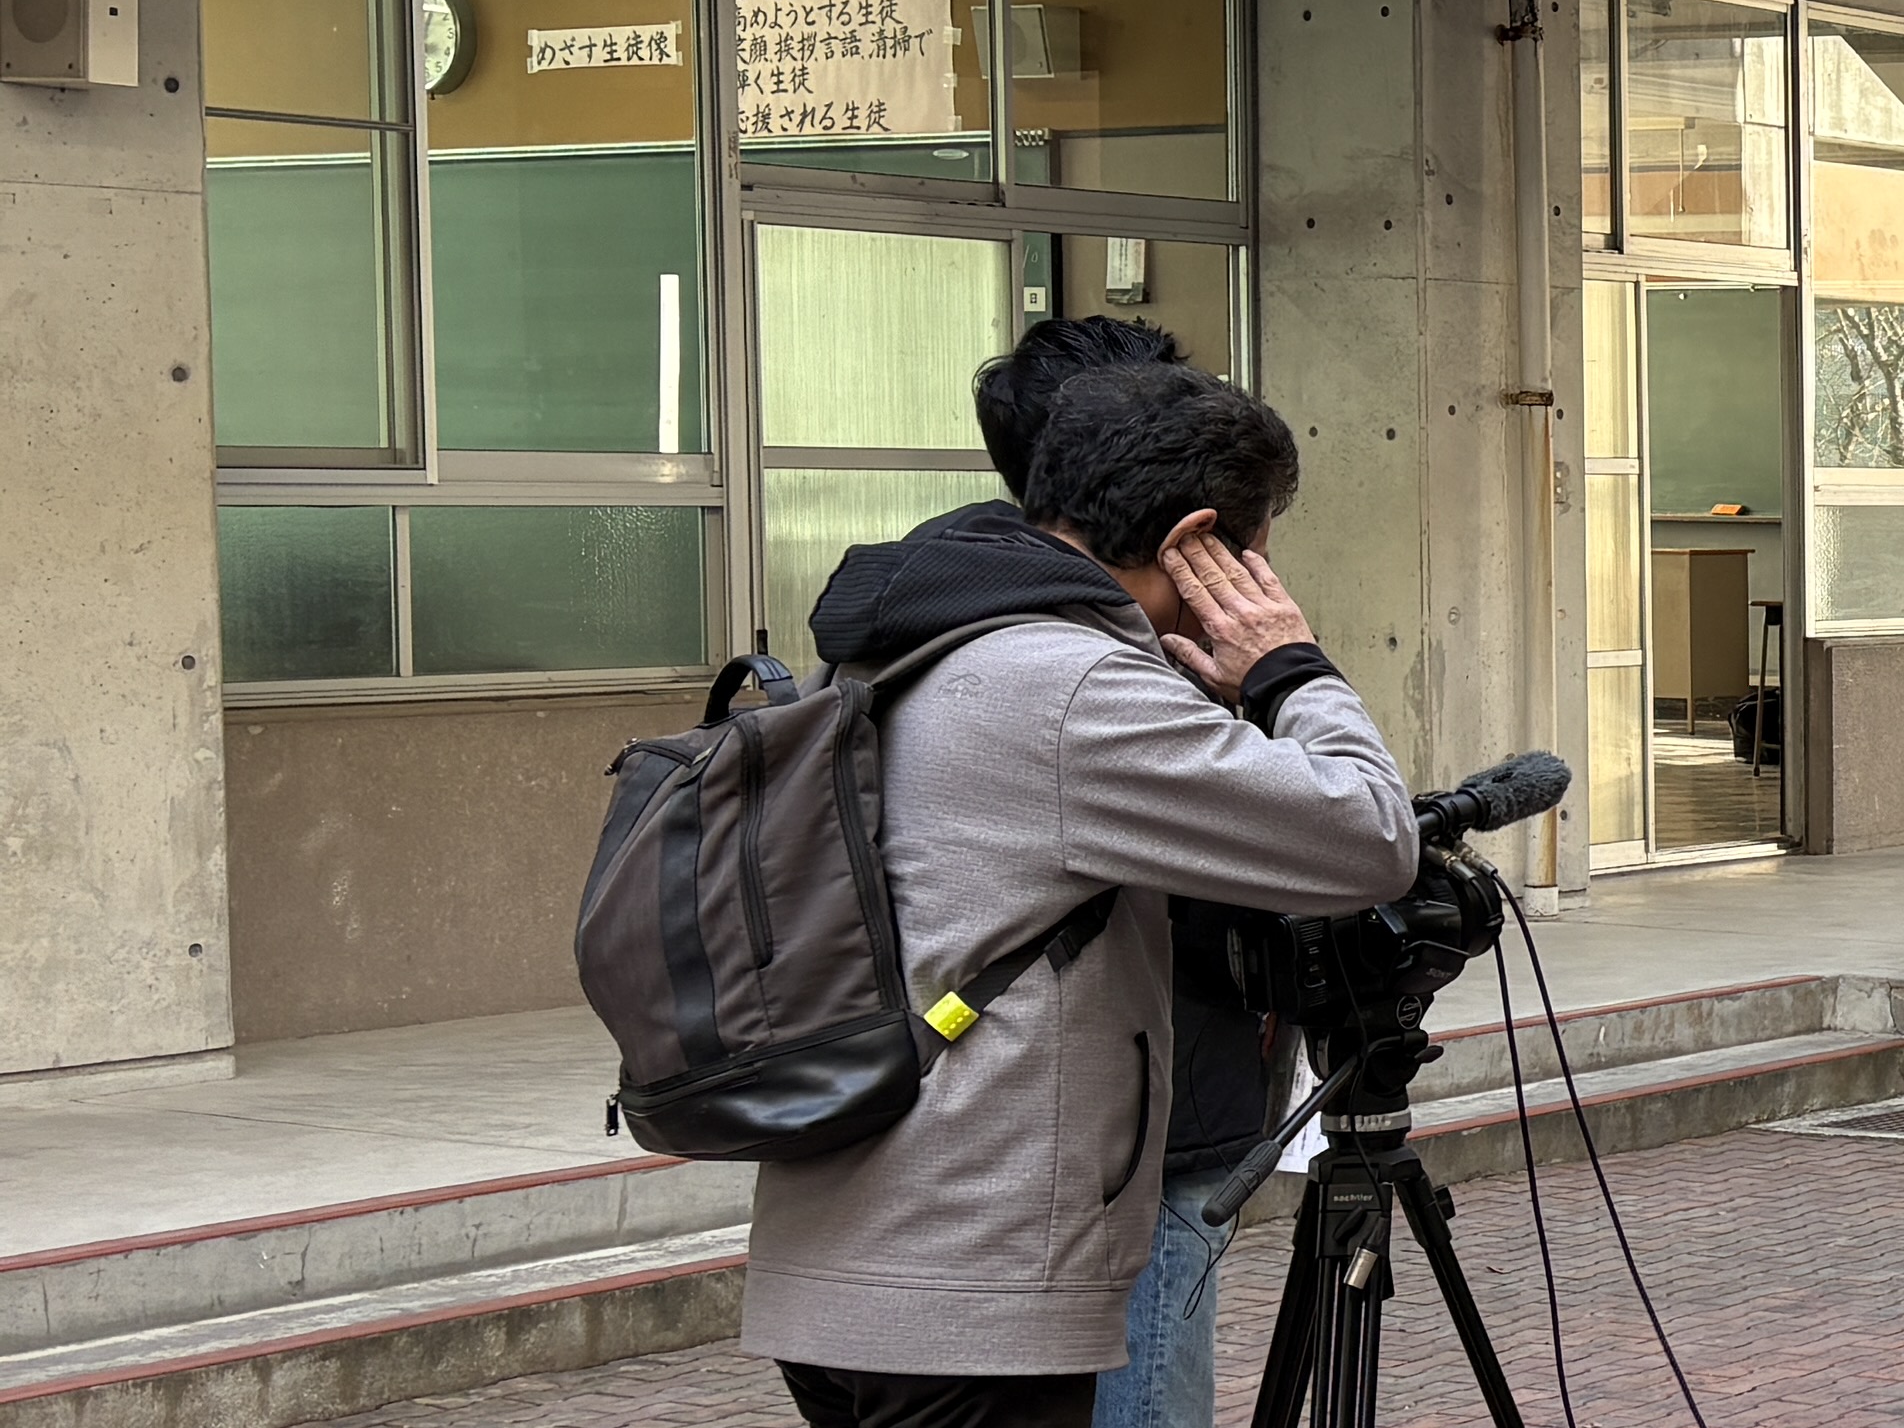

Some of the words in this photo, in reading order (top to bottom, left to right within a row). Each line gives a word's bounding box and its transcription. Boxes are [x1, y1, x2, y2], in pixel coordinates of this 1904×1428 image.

[537, 30, 672, 67] めざす生徒像
